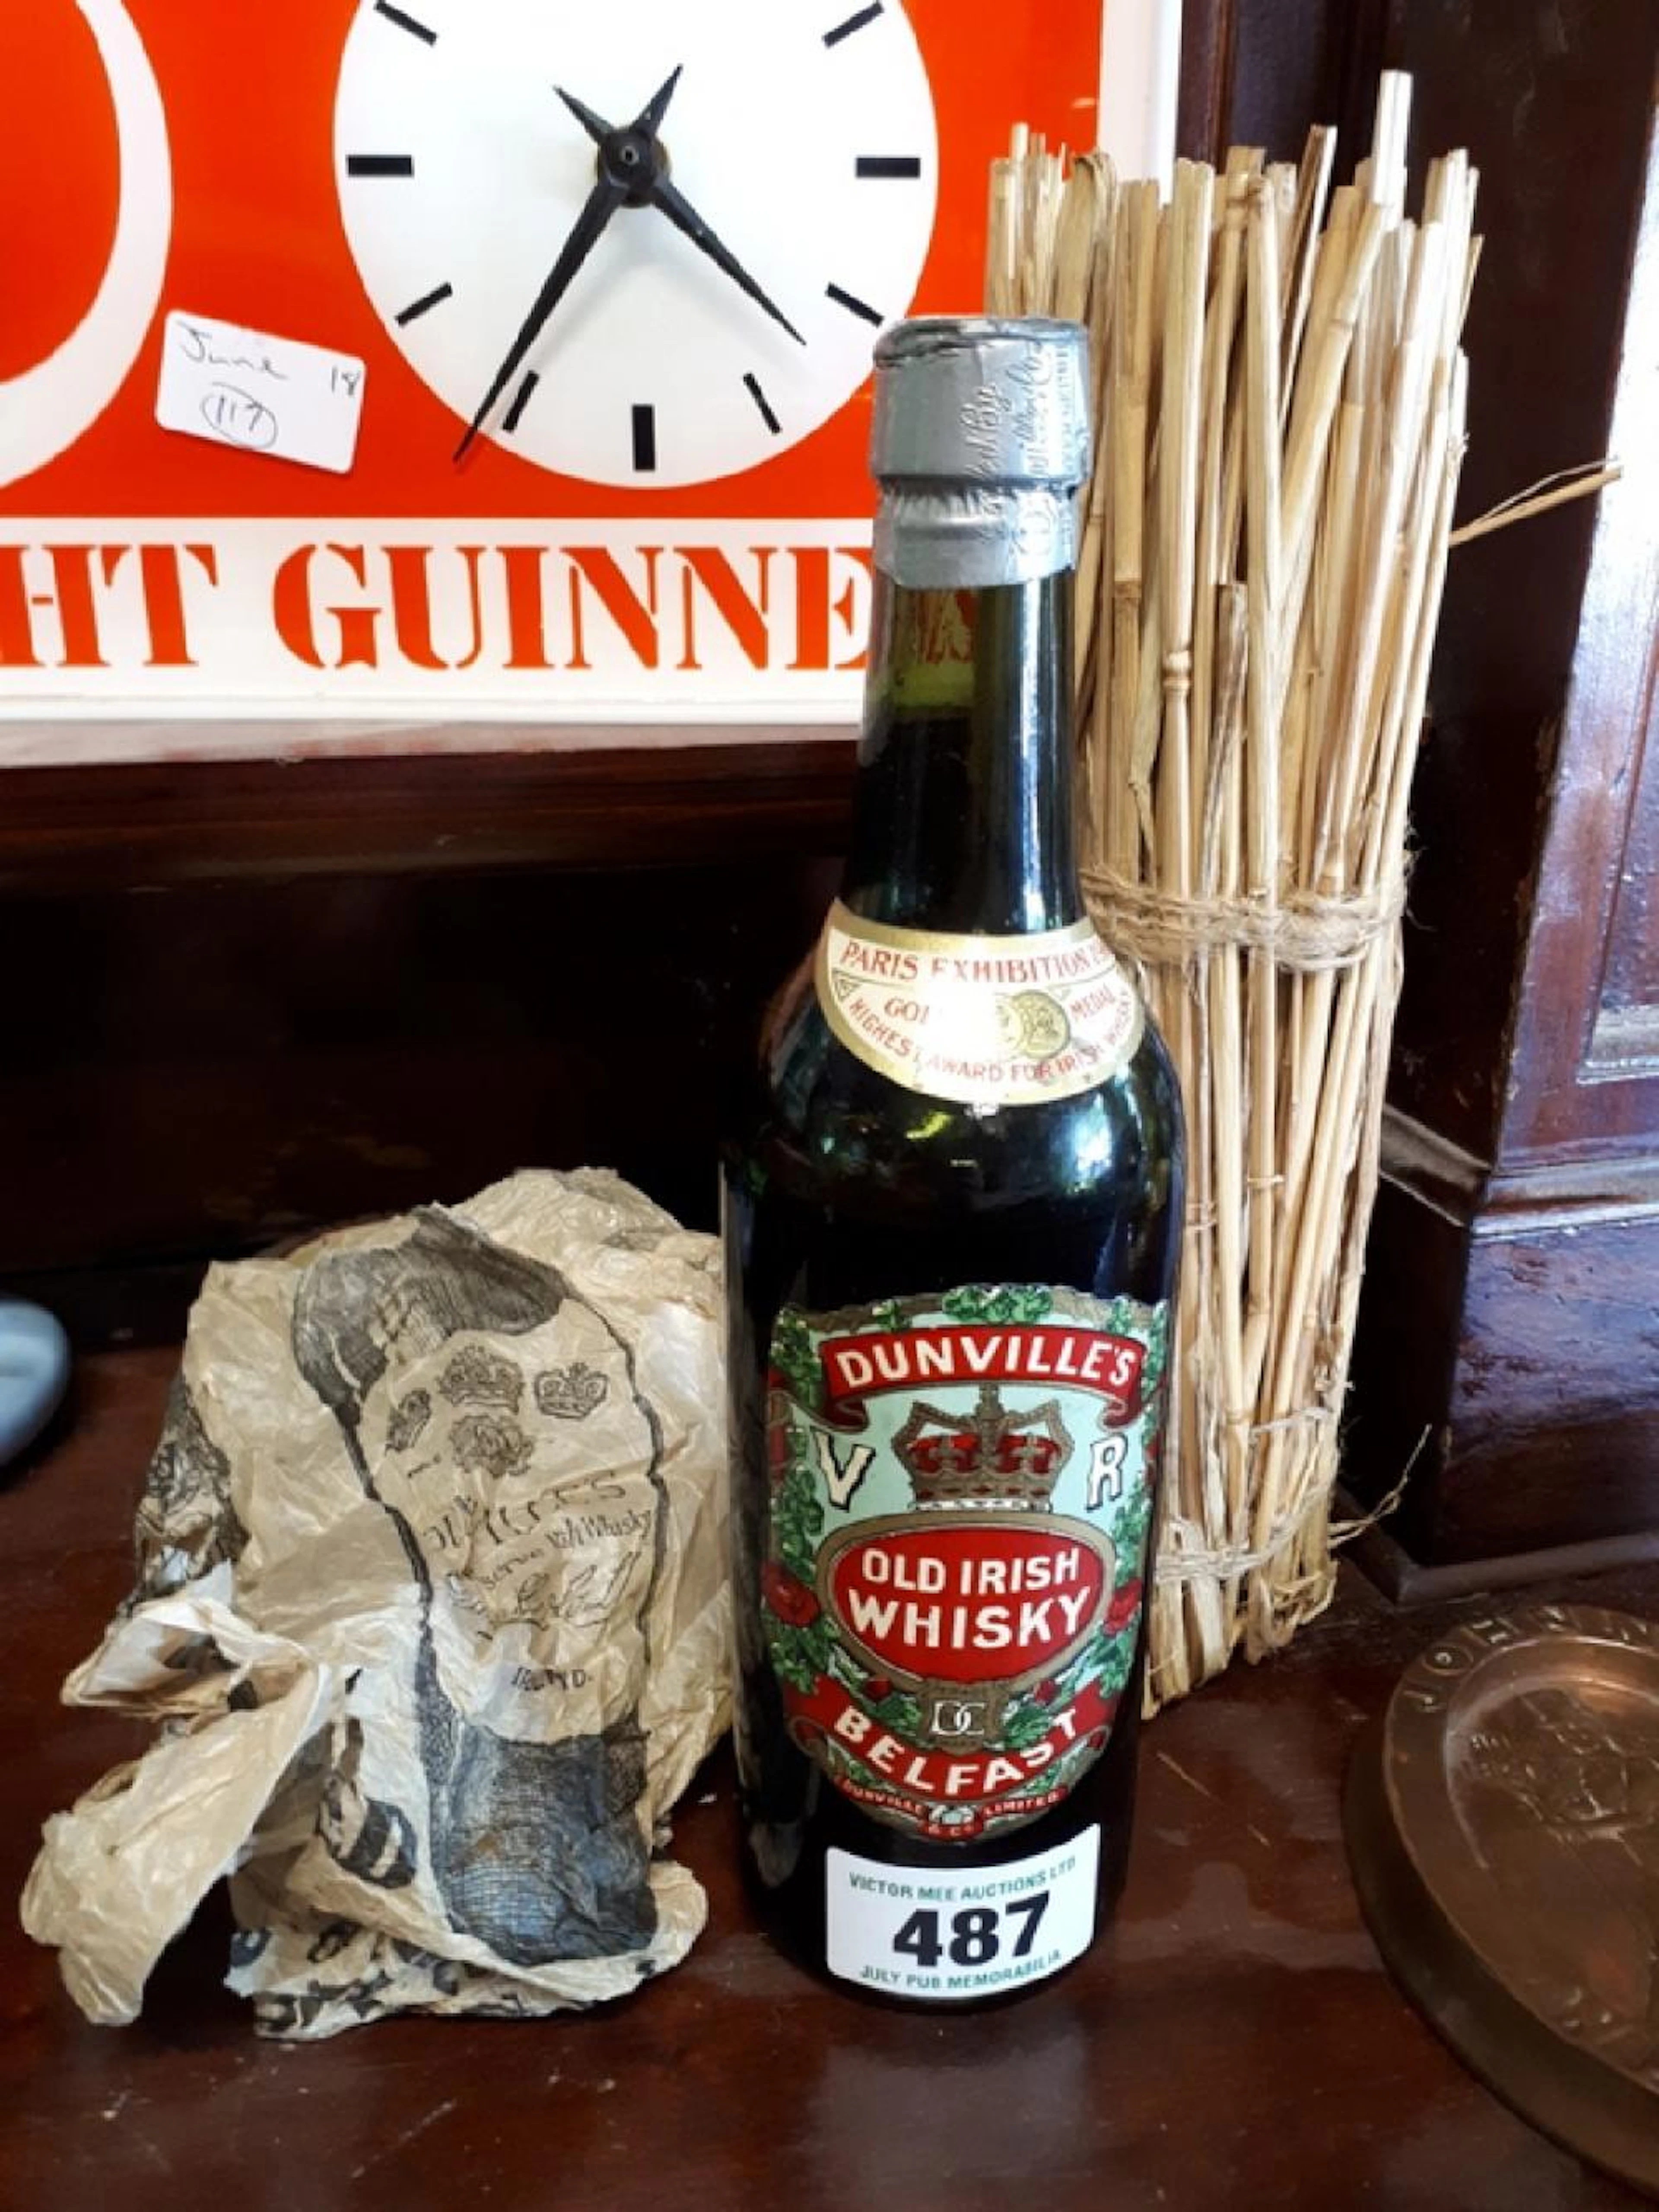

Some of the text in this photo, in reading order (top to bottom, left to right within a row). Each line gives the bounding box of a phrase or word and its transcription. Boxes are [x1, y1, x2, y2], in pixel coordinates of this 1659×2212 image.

[178, 321, 288, 379] June
[273, 544, 873, 670] GUINNE
[840, 941, 919, 980] PARIS
[836, 1335, 1135, 1388] DUNVILLE'S
[810, 1427, 1129, 1512] V R
[862, 1547, 1079, 1595] OLD IRISH
[848, 1585, 1090, 1649] WHISKY
[834, 1705, 1077, 1795] BELFAST
[849, 1856, 1076, 1902] VICTOR MEE AUCTIONS LTD
[893, 1890, 1051, 1968] 487
[861, 1949, 1061, 1989] JULY PUB MEMORABILIA
